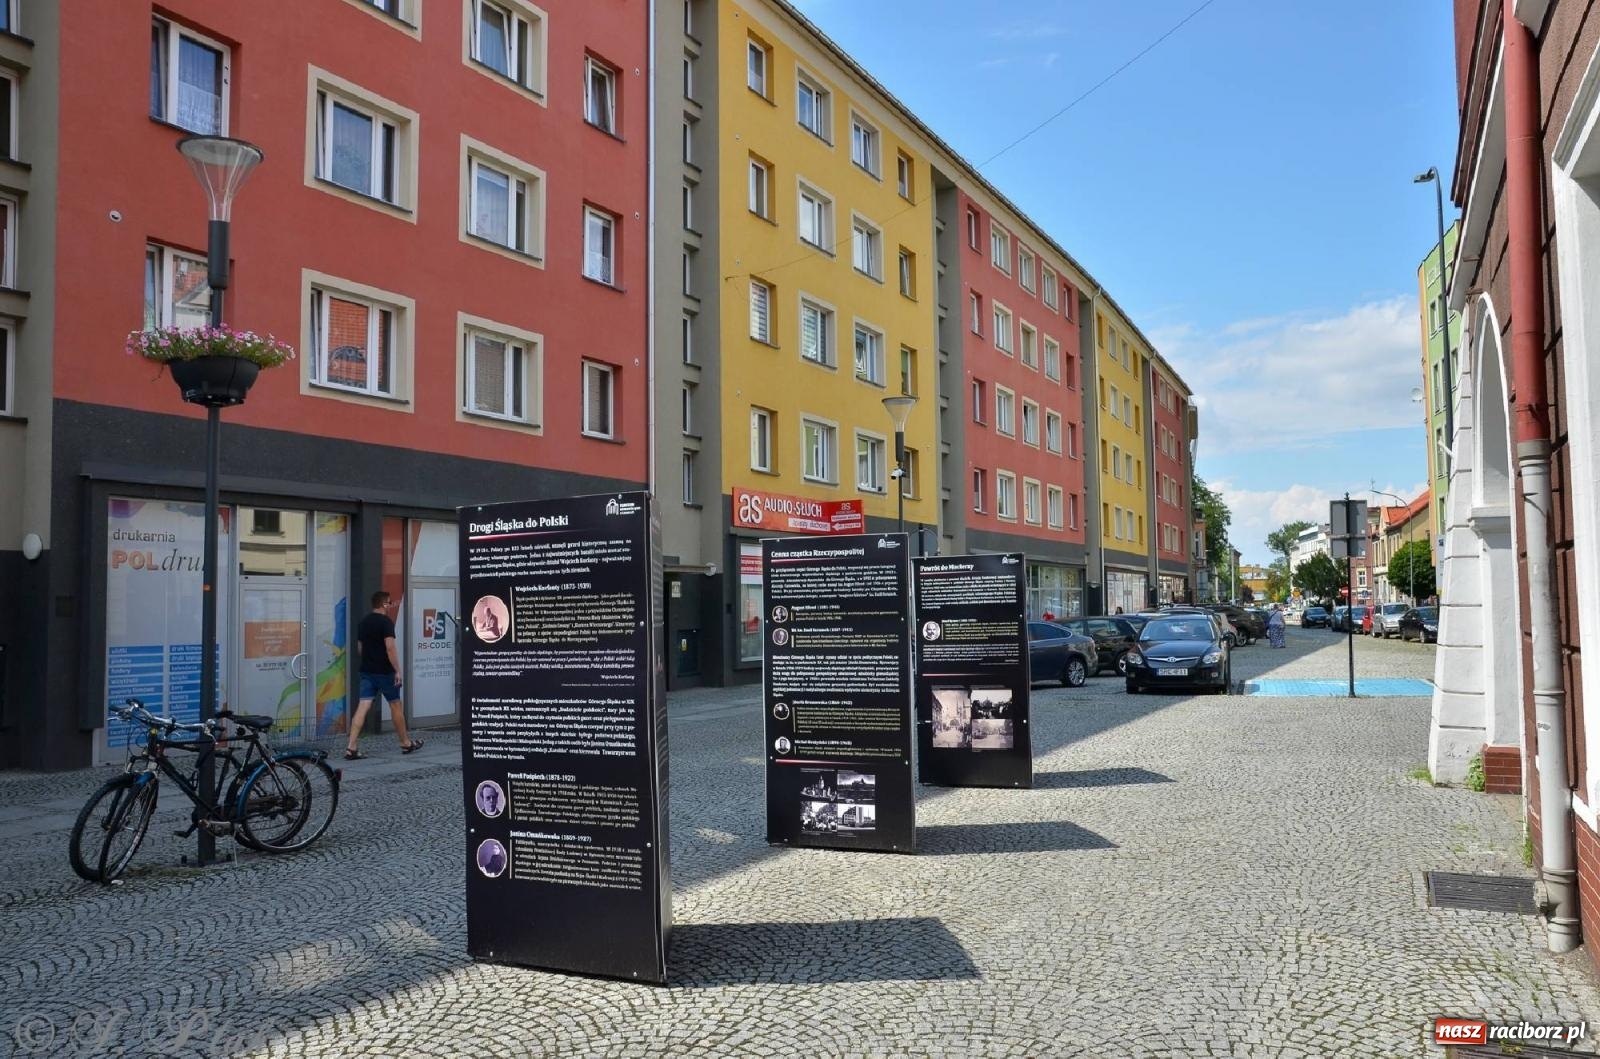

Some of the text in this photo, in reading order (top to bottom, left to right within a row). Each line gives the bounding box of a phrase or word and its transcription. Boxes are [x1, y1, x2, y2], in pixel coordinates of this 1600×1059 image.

[739, 494, 763, 524] as
[469, 515, 568, 535] Drogi Śląska do Polski
[112, 528, 176, 543] drukarnia
[112, 548, 205, 571] POLdru
[813, 548, 864, 557] Rzeczypospolitej
[418, 642, 452, 650] RS-CODE
